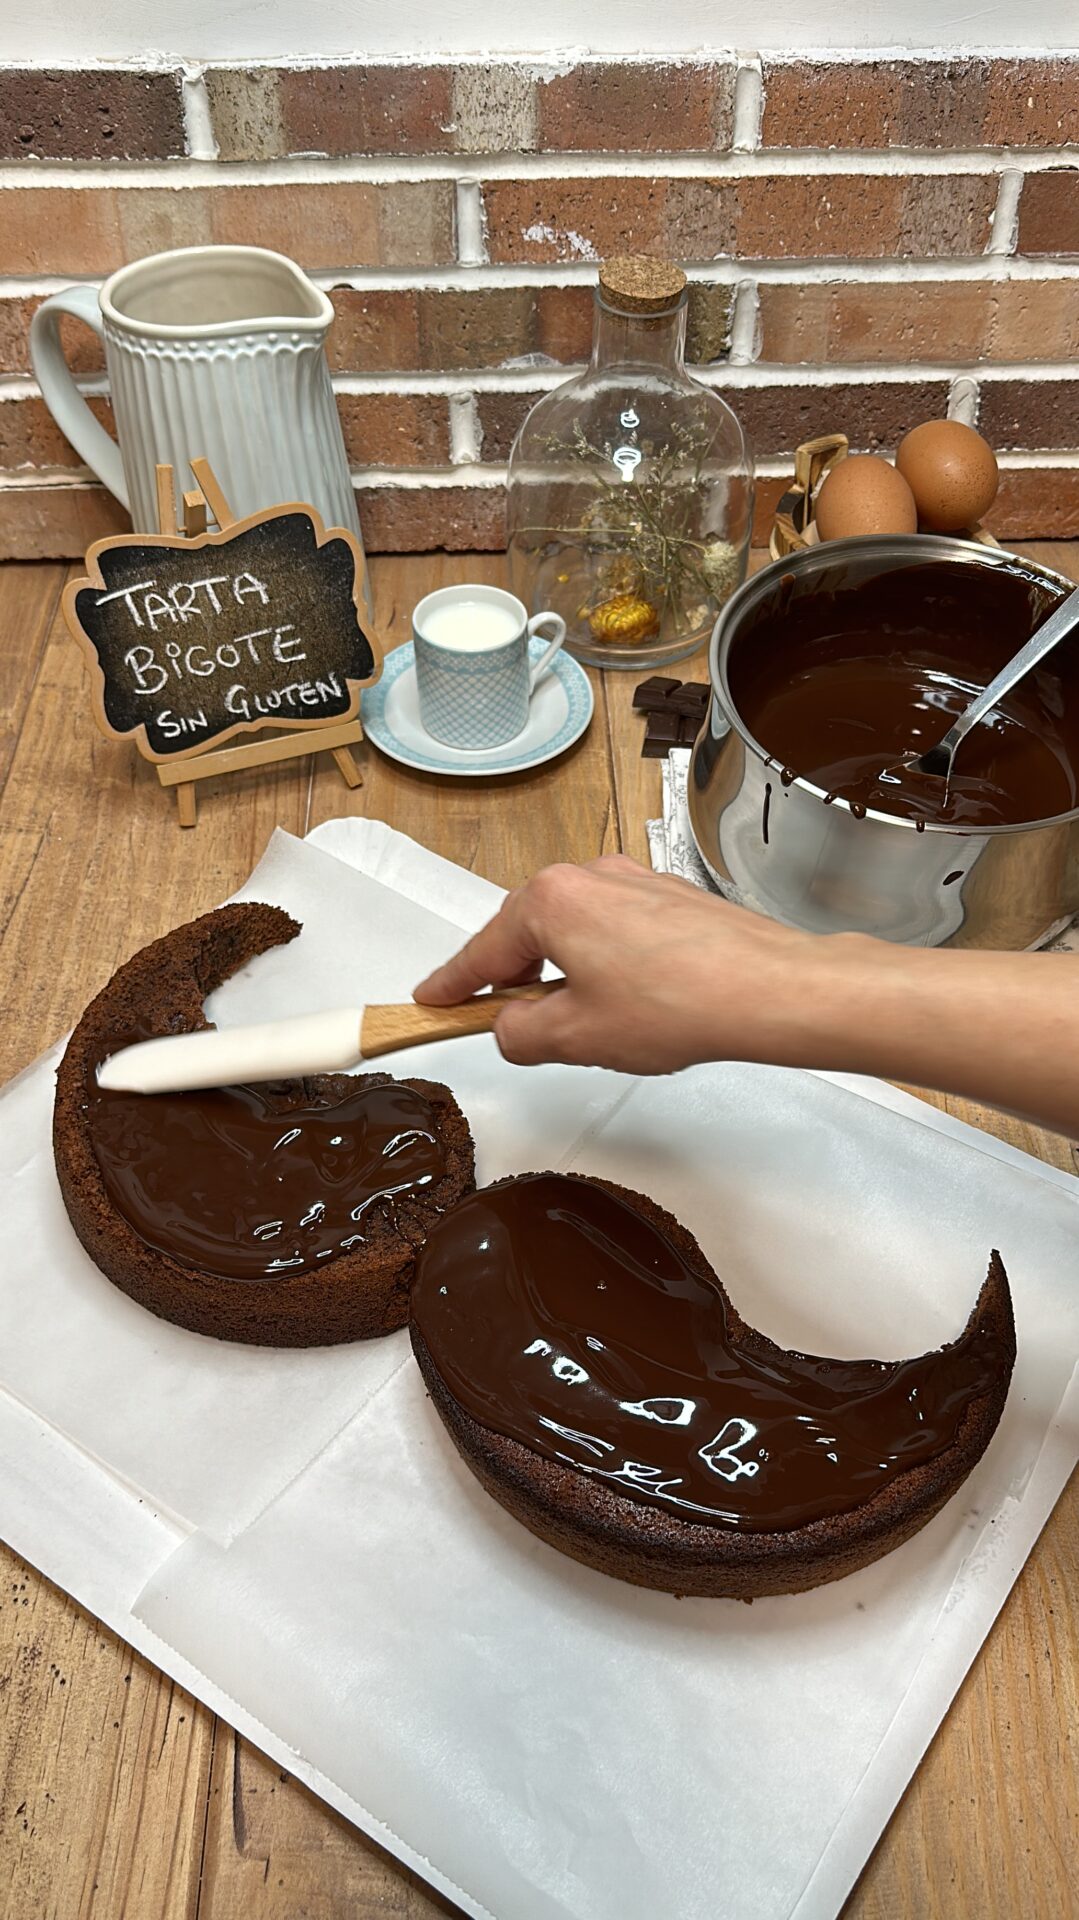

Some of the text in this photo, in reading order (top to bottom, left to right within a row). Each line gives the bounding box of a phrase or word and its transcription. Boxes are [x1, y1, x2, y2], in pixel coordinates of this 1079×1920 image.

[95, 572, 270, 632] TARTA
[156, 671, 343, 738] SIN GLUTEN
